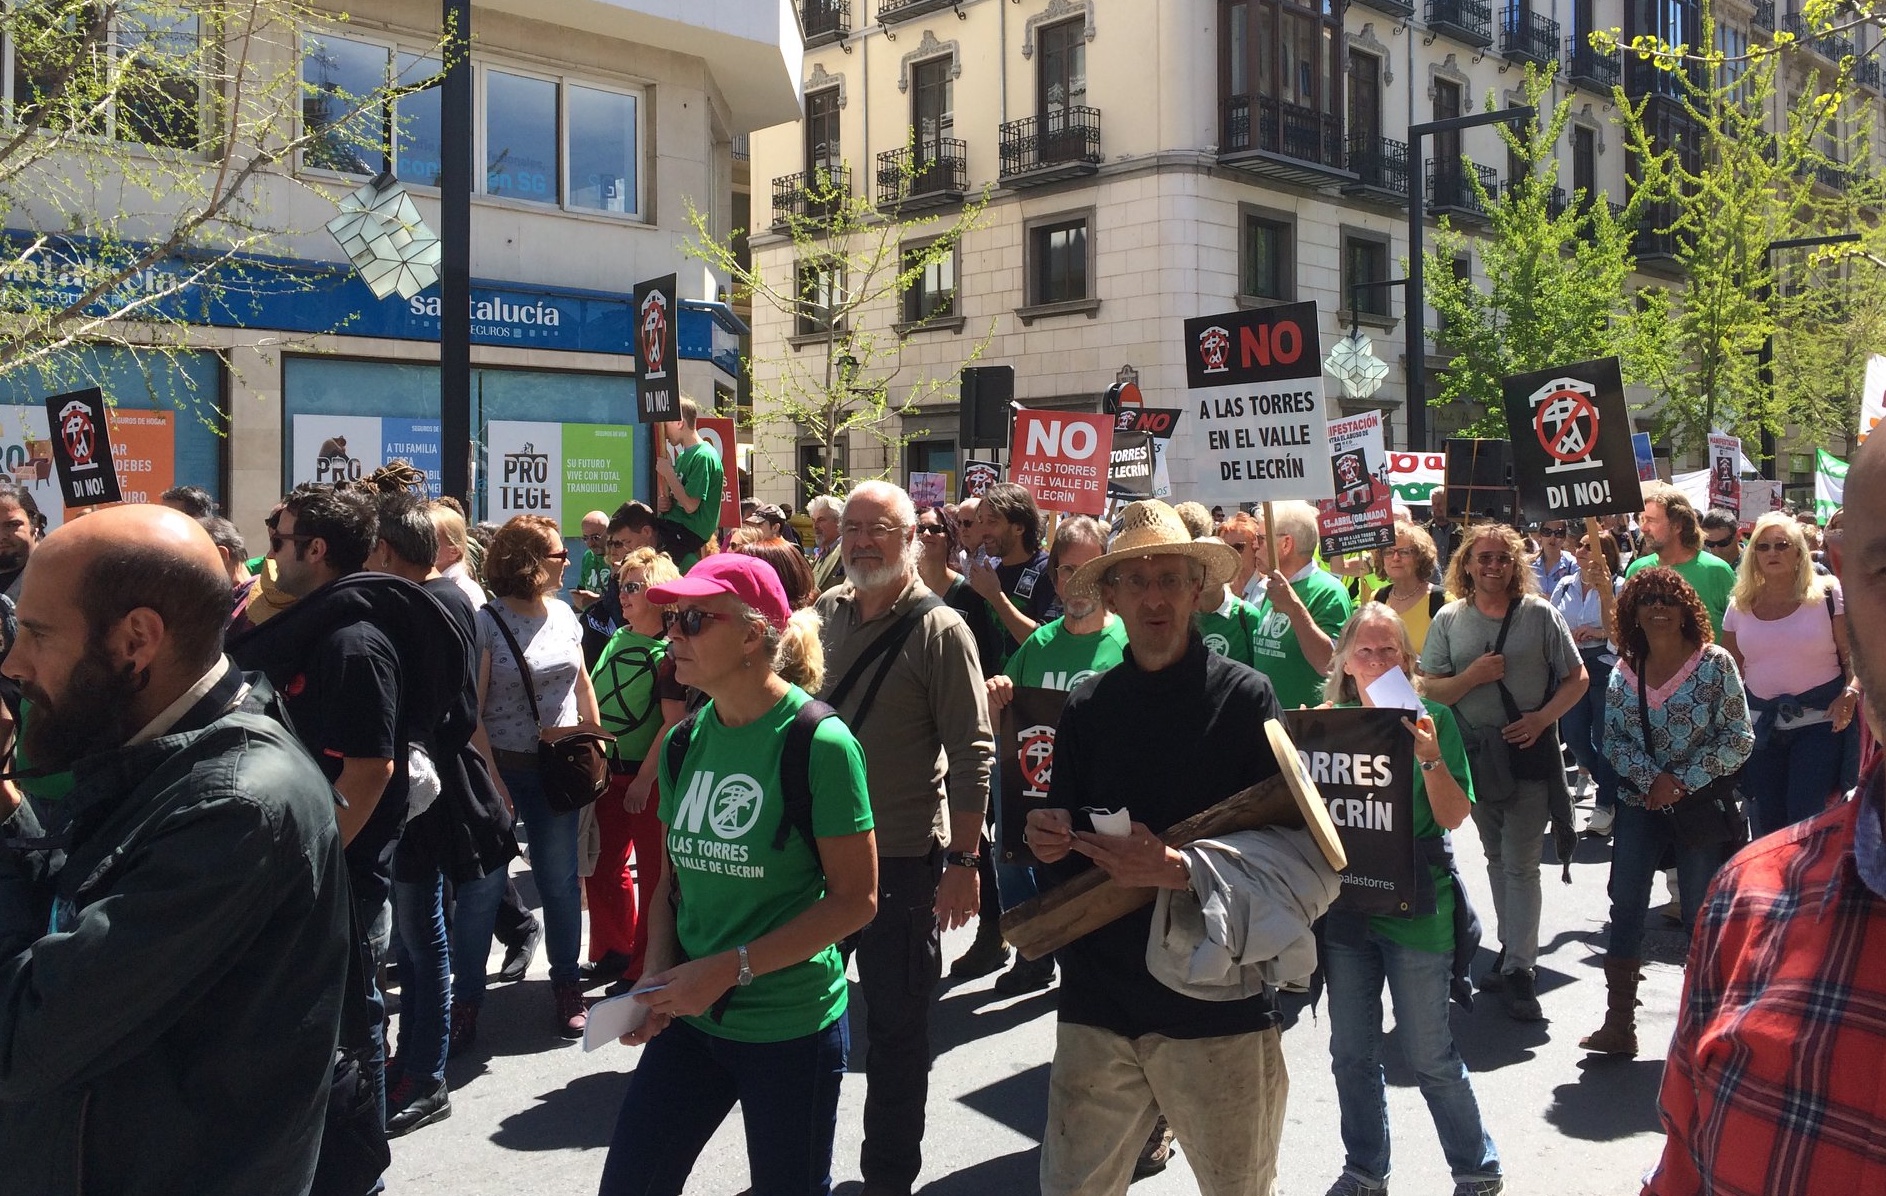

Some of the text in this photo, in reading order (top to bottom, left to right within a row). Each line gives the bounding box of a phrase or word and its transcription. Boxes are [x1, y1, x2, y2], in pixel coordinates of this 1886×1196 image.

[410, 294, 560, 326] satalucía
[470, 324, 510, 338] EGUROS
[1240, 320, 1303, 368] NO
[645, 390, 670, 413] DI NO!
[1200, 391, 1314, 419] A LAS TORRES
[1135, 413, 1170, 432] NO
[1328, 414, 1378, 437] IFESTACIÓN
[386, 443, 437, 454] A TU FAMILIA
[1026, 419, 1098, 460] NO
[1209, 425, 1310, 450] EN EL VALLE
[112, 444, 127, 456] AR
[1110, 446, 1147, 463] TORRES
[117, 460, 152, 472] DEBES
[504, 455, 548, 483] PRO
[567, 459, 611, 468] SU FUTURO Y
[1022, 461, 1097, 476] A LAS TORRES
[1115, 463, 1149, 478] LECRÍN
[1221, 453, 1304, 480] DE LECRÍN
[567, 471, 620, 481] VIVE CON TOTAL
[1018, 474, 1099, 490] EN EL VALLE DE
[72, 478, 105, 498] DI NO!
[122, 492, 150, 504] URO.
[499, 486, 551, 509] TEGE
[567, 483, 620, 493] TRANQUILIDAD.
[1037, 490, 1075, 502] LECRÍN
[1547, 480, 1612, 509] DI NO!
[1298, 750, 1393, 787] RRES
[674, 771, 763, 839] NO
[1322, 793, 1393, 832] CRÍN
[672, 835, 749, 862] LAS TORRES
[679, 856, 708, 871] VALLE
[709, 861, 723, 874] DE
[724, 864, 764, 878] LECRIN
